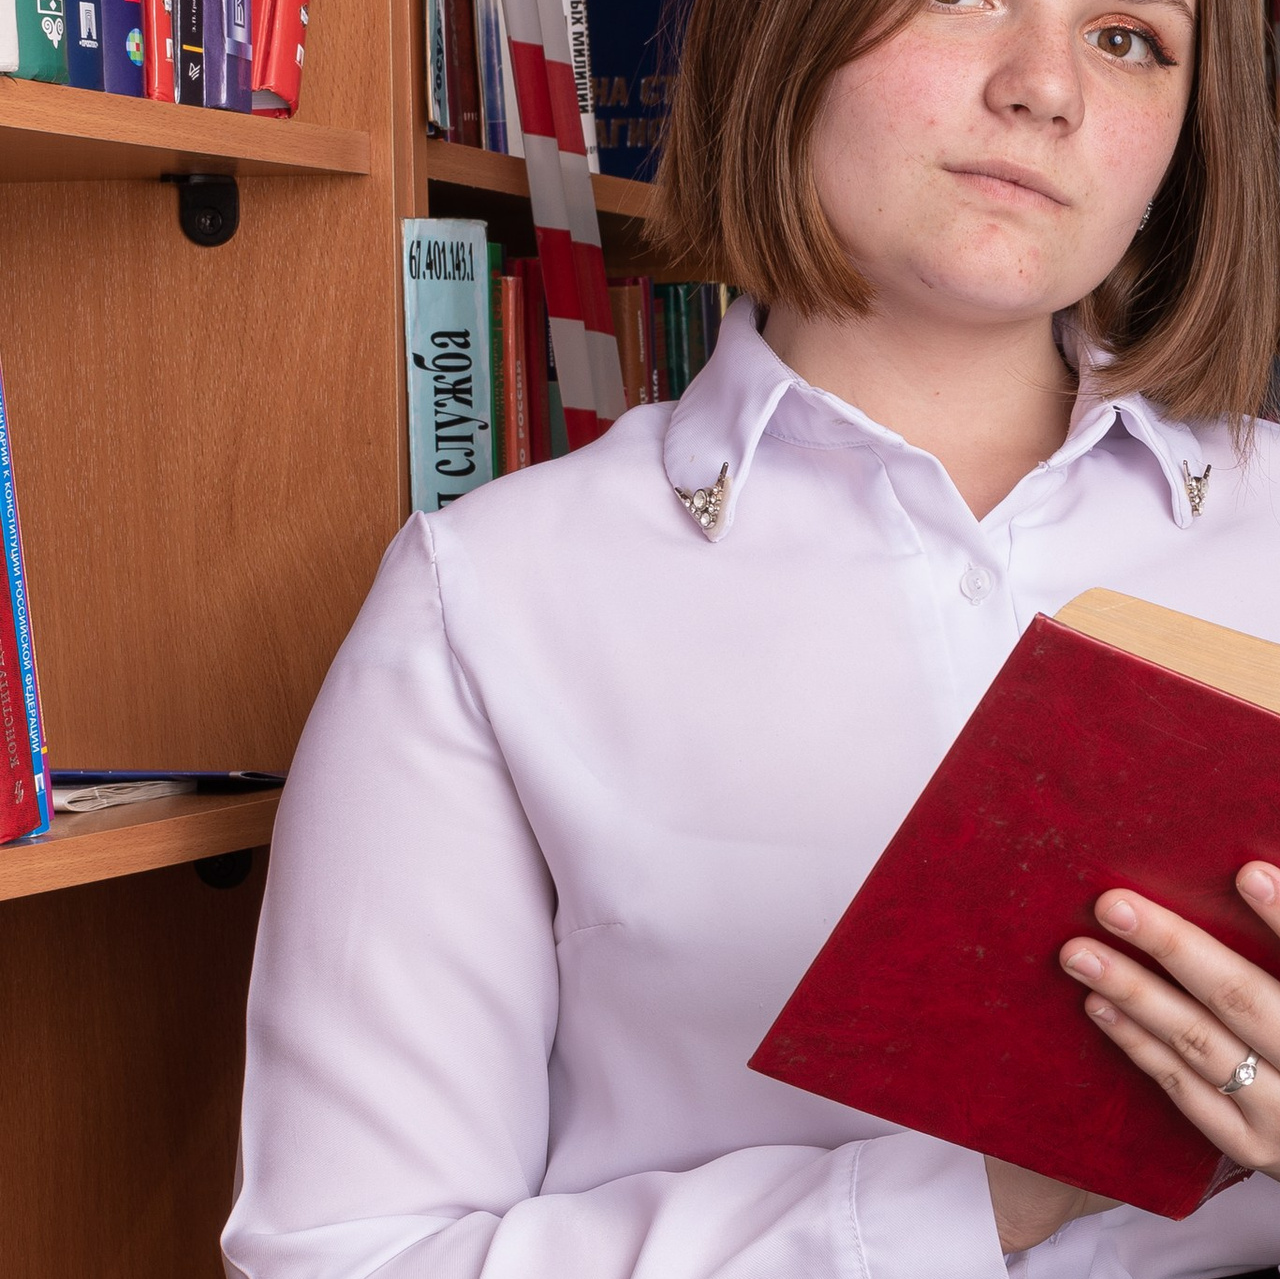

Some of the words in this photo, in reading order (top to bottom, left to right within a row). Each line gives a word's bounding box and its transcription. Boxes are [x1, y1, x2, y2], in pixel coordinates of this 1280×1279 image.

[572, 31, 590, 114] МИЛИЦИИ
[408, 239, 475, 282] 67.401.143.1
[412, 328, 489, 478] служба
[515, 360, 525, 439] РОССИИ
[3, 469, 10, 479] К
[4, 481, 21, 577] КОНСТИТУЦИИ
[15, 580, 33, 670] РОССИЙСКОЙ
[25, 674, 40, 753] ФЕДЕРАЦИИ
